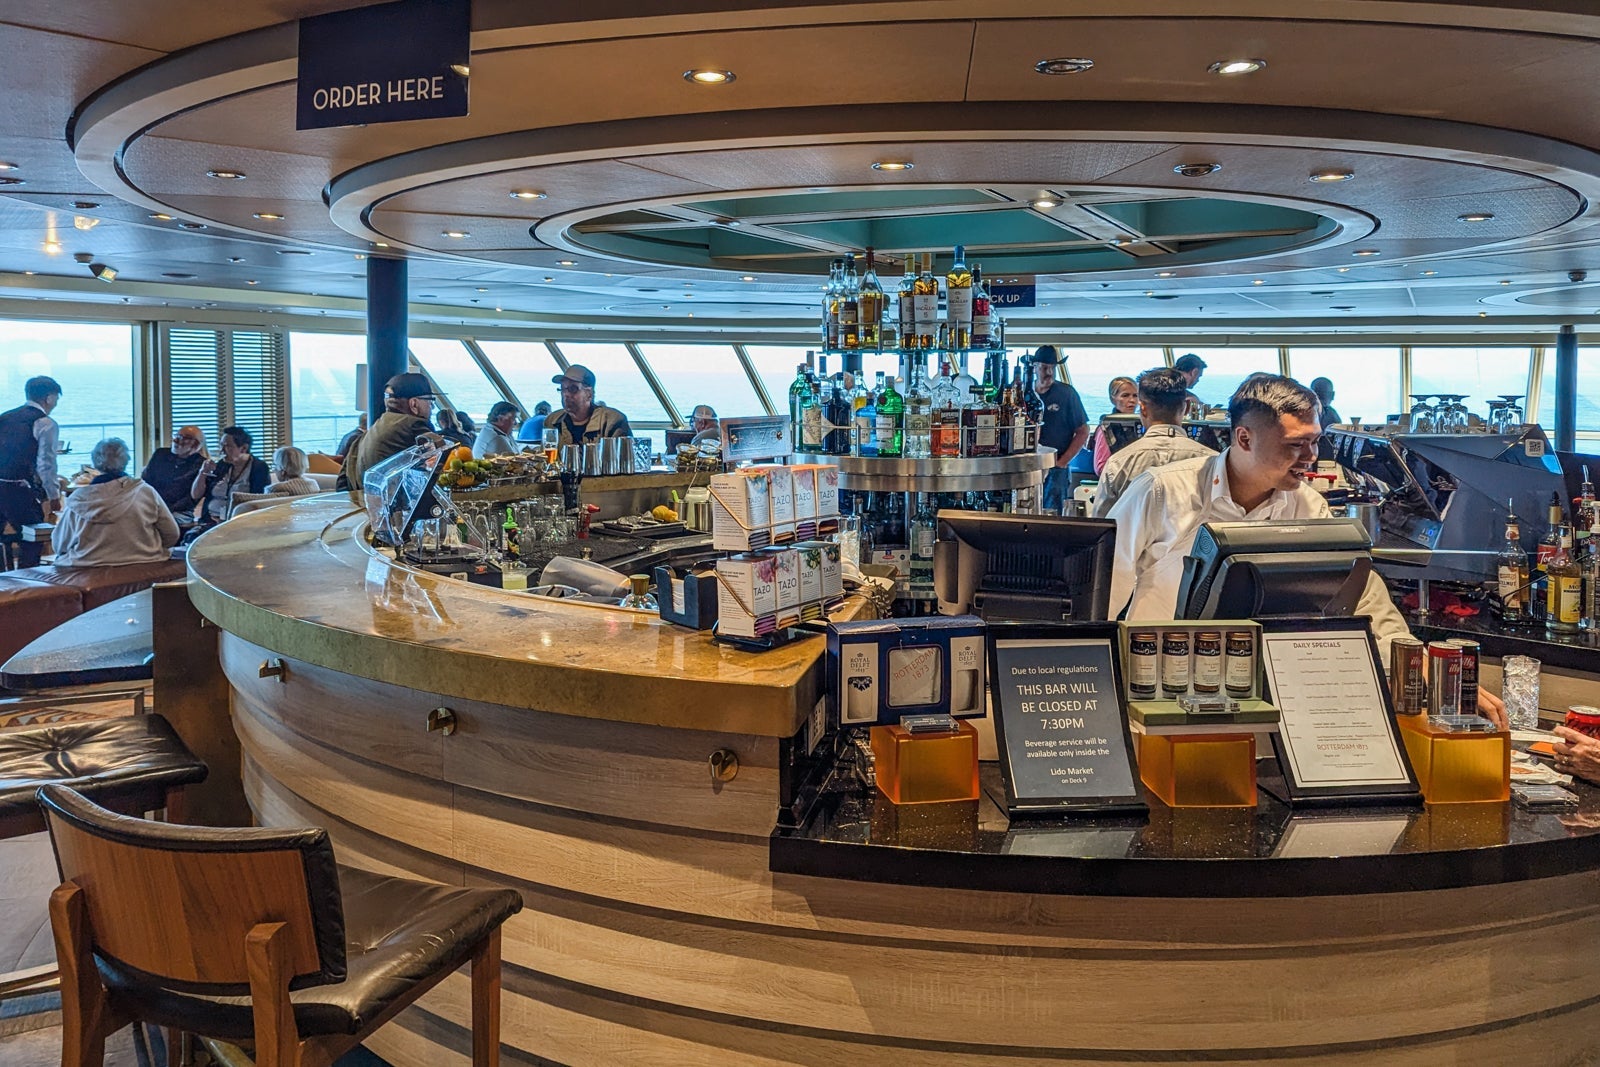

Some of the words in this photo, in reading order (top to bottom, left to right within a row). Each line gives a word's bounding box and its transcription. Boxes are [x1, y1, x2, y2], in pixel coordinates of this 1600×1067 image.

[313, 82, 380, 110] ORDER
[388, 76, 444, 102] HERE
[990, 294, 1004, 303] CK
[1007, 294, 1020, 302] UP
[772, 494, 791, 505] TAZO
[795, 493, 811, 502] TAZO
[819, 490, 835, 499] TAZO
[1539, 552, 1553, 564] Tor
[802, 571, 814, 579] TAZO
[778, 578, 797, 590] TAZO
[754, 584, 771, 596] TAZO
[893, 648, 936, 681] ROTTERDAM
[1012, 667, 1026, 675] Due
[1038, 666, 1055, 674] local
[1057, 665, 1098, 675] regulations
[912, 665, 930, 680] 1873
[1017, 684, 1042, 695] THIS
[1045, 684, 1067, 694] BAR
[1069, 683, 1098, 694] WILL
[1022, 702, 1035, 713] BE
[1038, 701, 1081, 712] CLOSED
[1084, 700, 1098, 710] AT
[1041, 718, 1085, 730] 7:30PM
[1025, 739, 1057, 748] Beverage
[1027, 750, 1057, 758] available
[1059, 750, 1074, 758] only
[1068, 767, 1094, 775] Market
